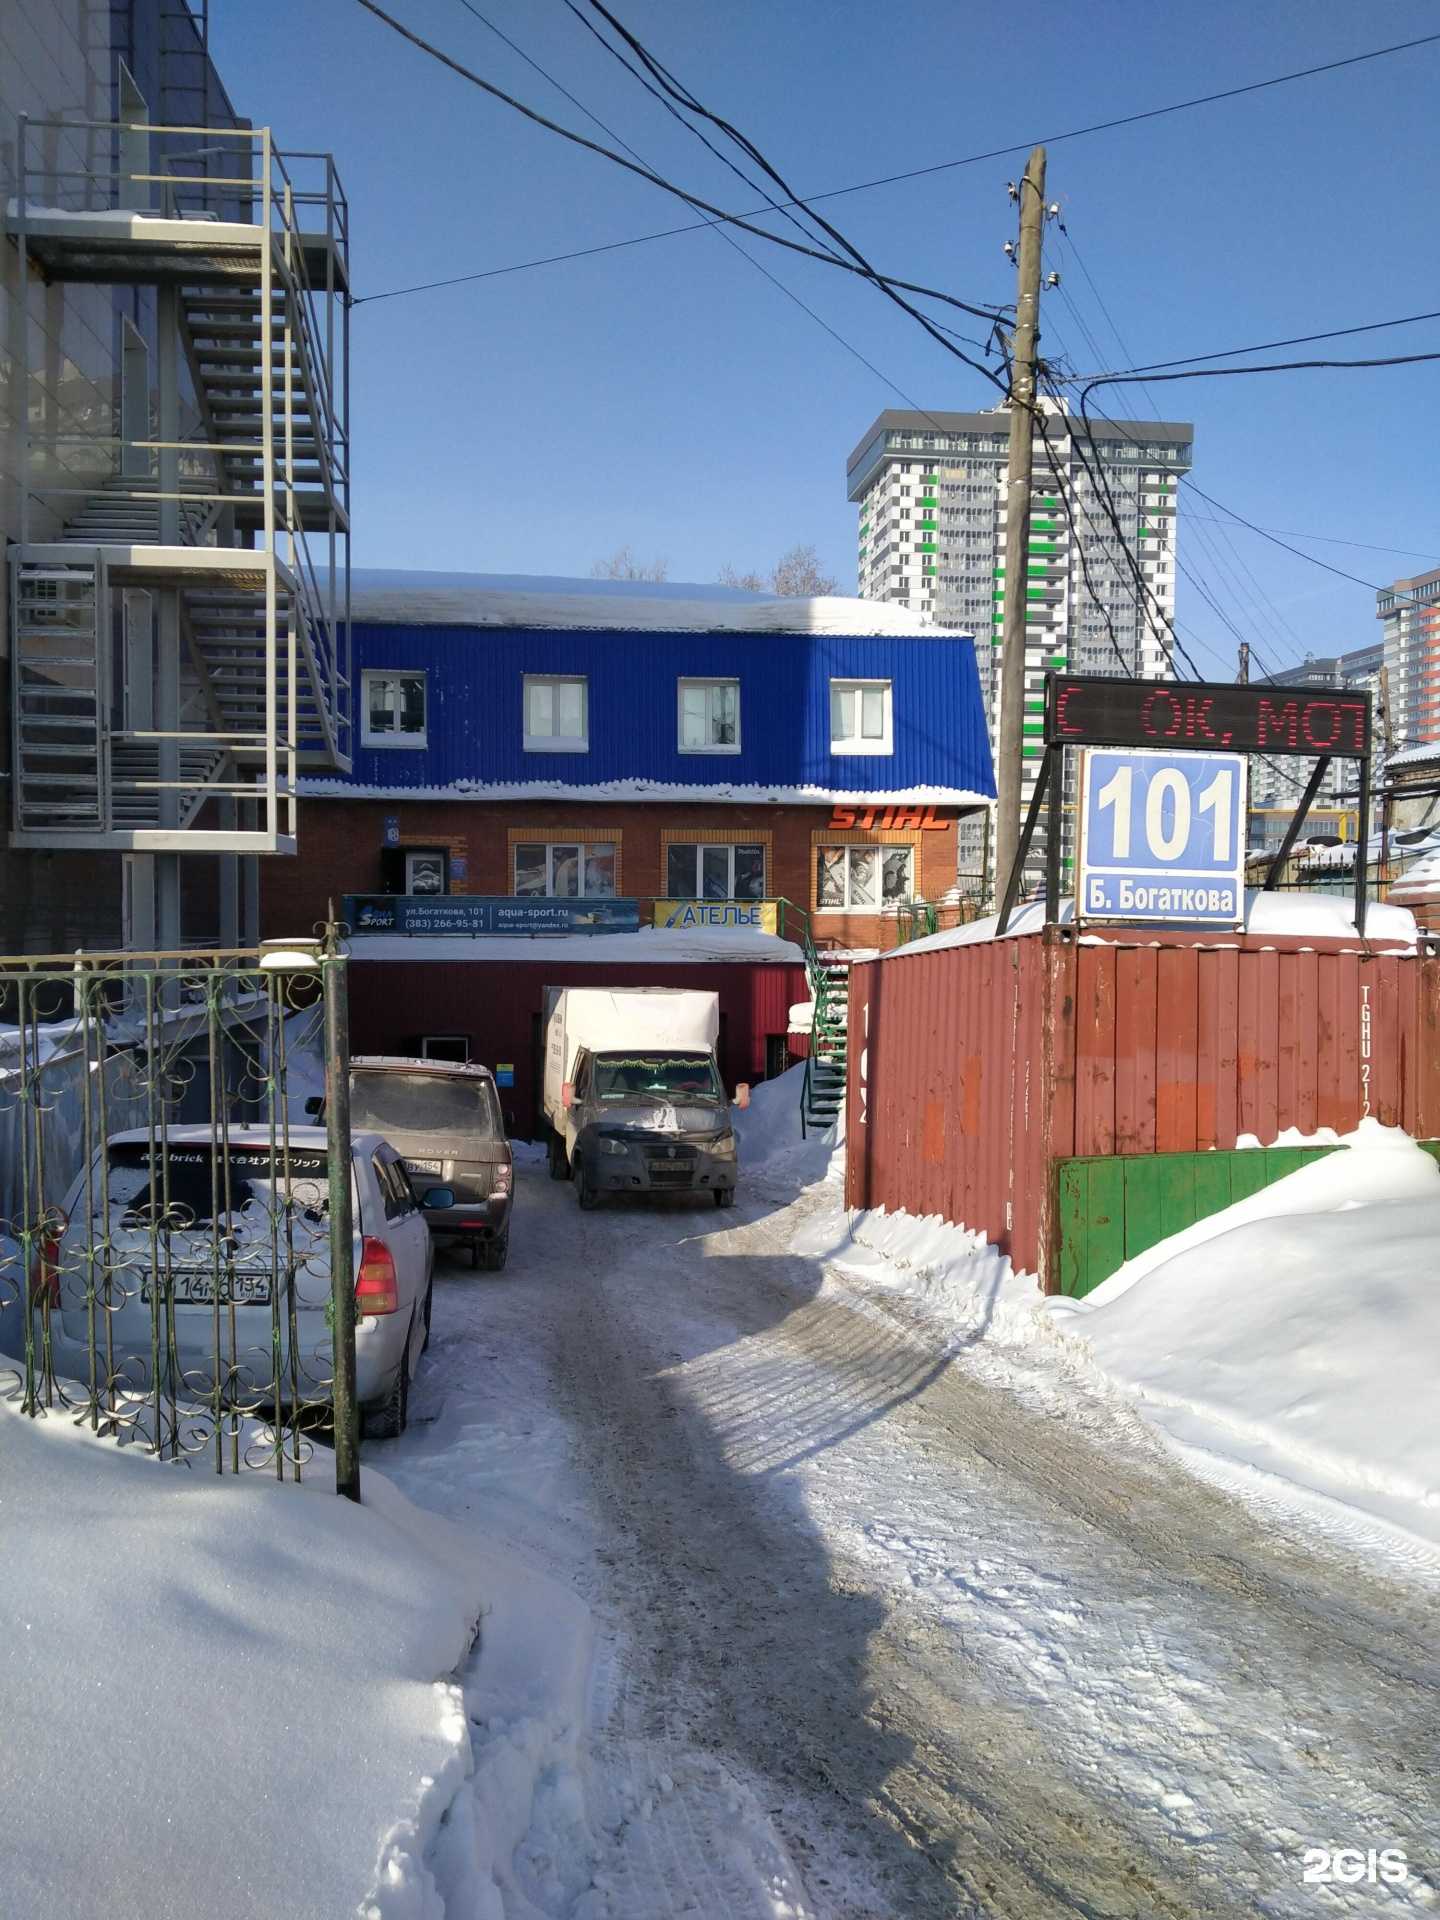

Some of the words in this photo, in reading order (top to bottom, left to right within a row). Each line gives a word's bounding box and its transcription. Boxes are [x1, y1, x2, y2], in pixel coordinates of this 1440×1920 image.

[828, 804, 950, 831] STIHL
[1098, 766, 1233, 862] 101
[1090, 879, 1112, 909] Б.
[1119, 879, 1233, 912] Богаткова
[469, 908, 484, 916] 101
[498, 907, 569, 918] aqua-sport.ru
[683, 905, 762, 925] АТЕЛЬЕ
[405, 919, 431, 929] (383)
[433, 919, 484, 928] 266-95-81
[1361, 985, 1371, 1058] TGHU
